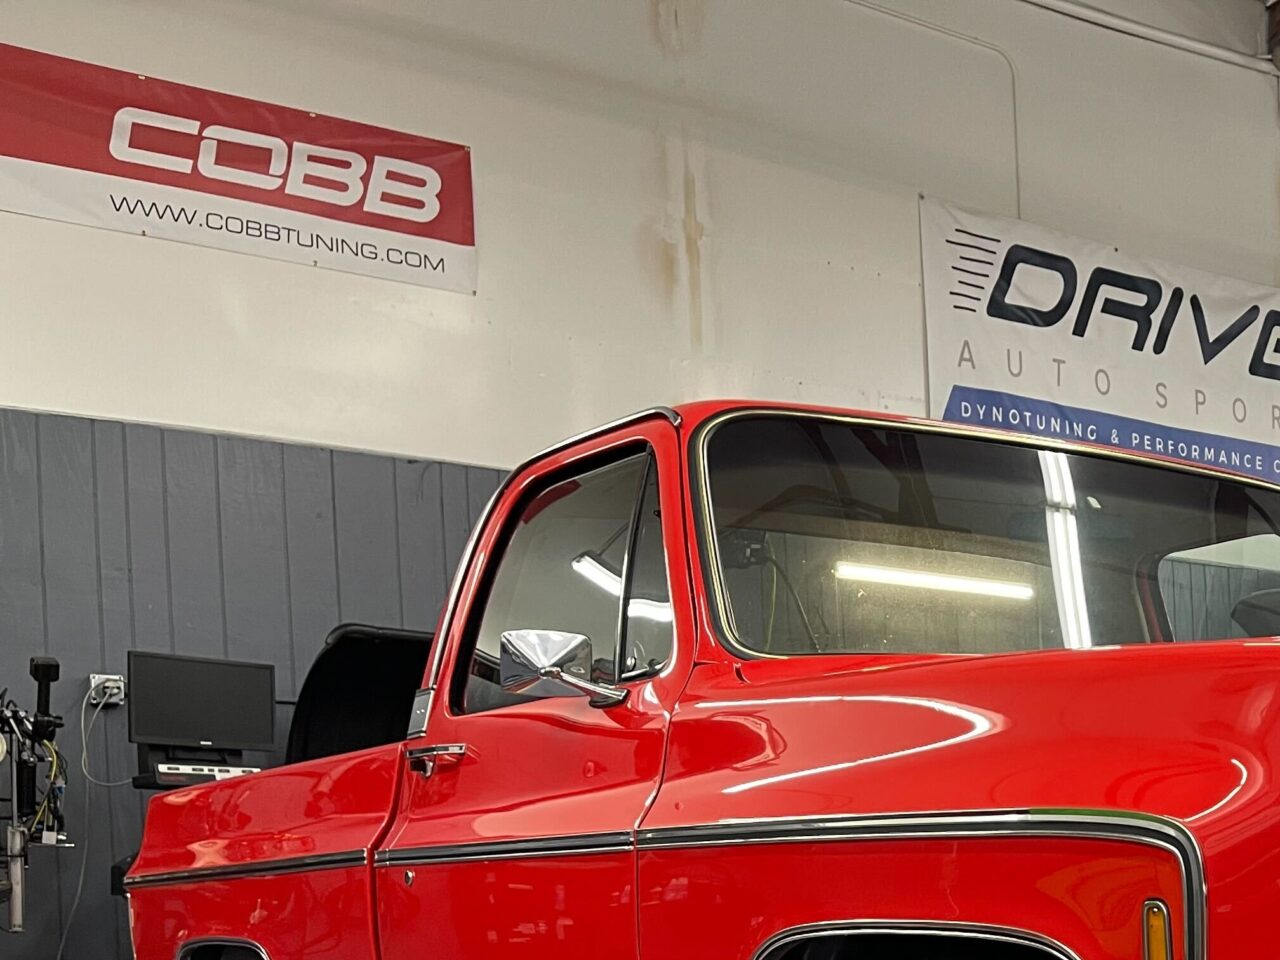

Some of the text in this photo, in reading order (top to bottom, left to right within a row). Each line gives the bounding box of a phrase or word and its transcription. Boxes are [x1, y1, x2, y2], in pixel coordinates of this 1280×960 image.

[109, 106, 442, 223] COBB
[110, 193, 446, 273] WWW.COBBTUNING.COM
[957, 339, 1111, 396] AUTO
[960, 401, 1097, 440] DYNOTUNING
[1110, 428, 1120, 445] &
[1131, 432, 1263, 471] PERFORMANCE
